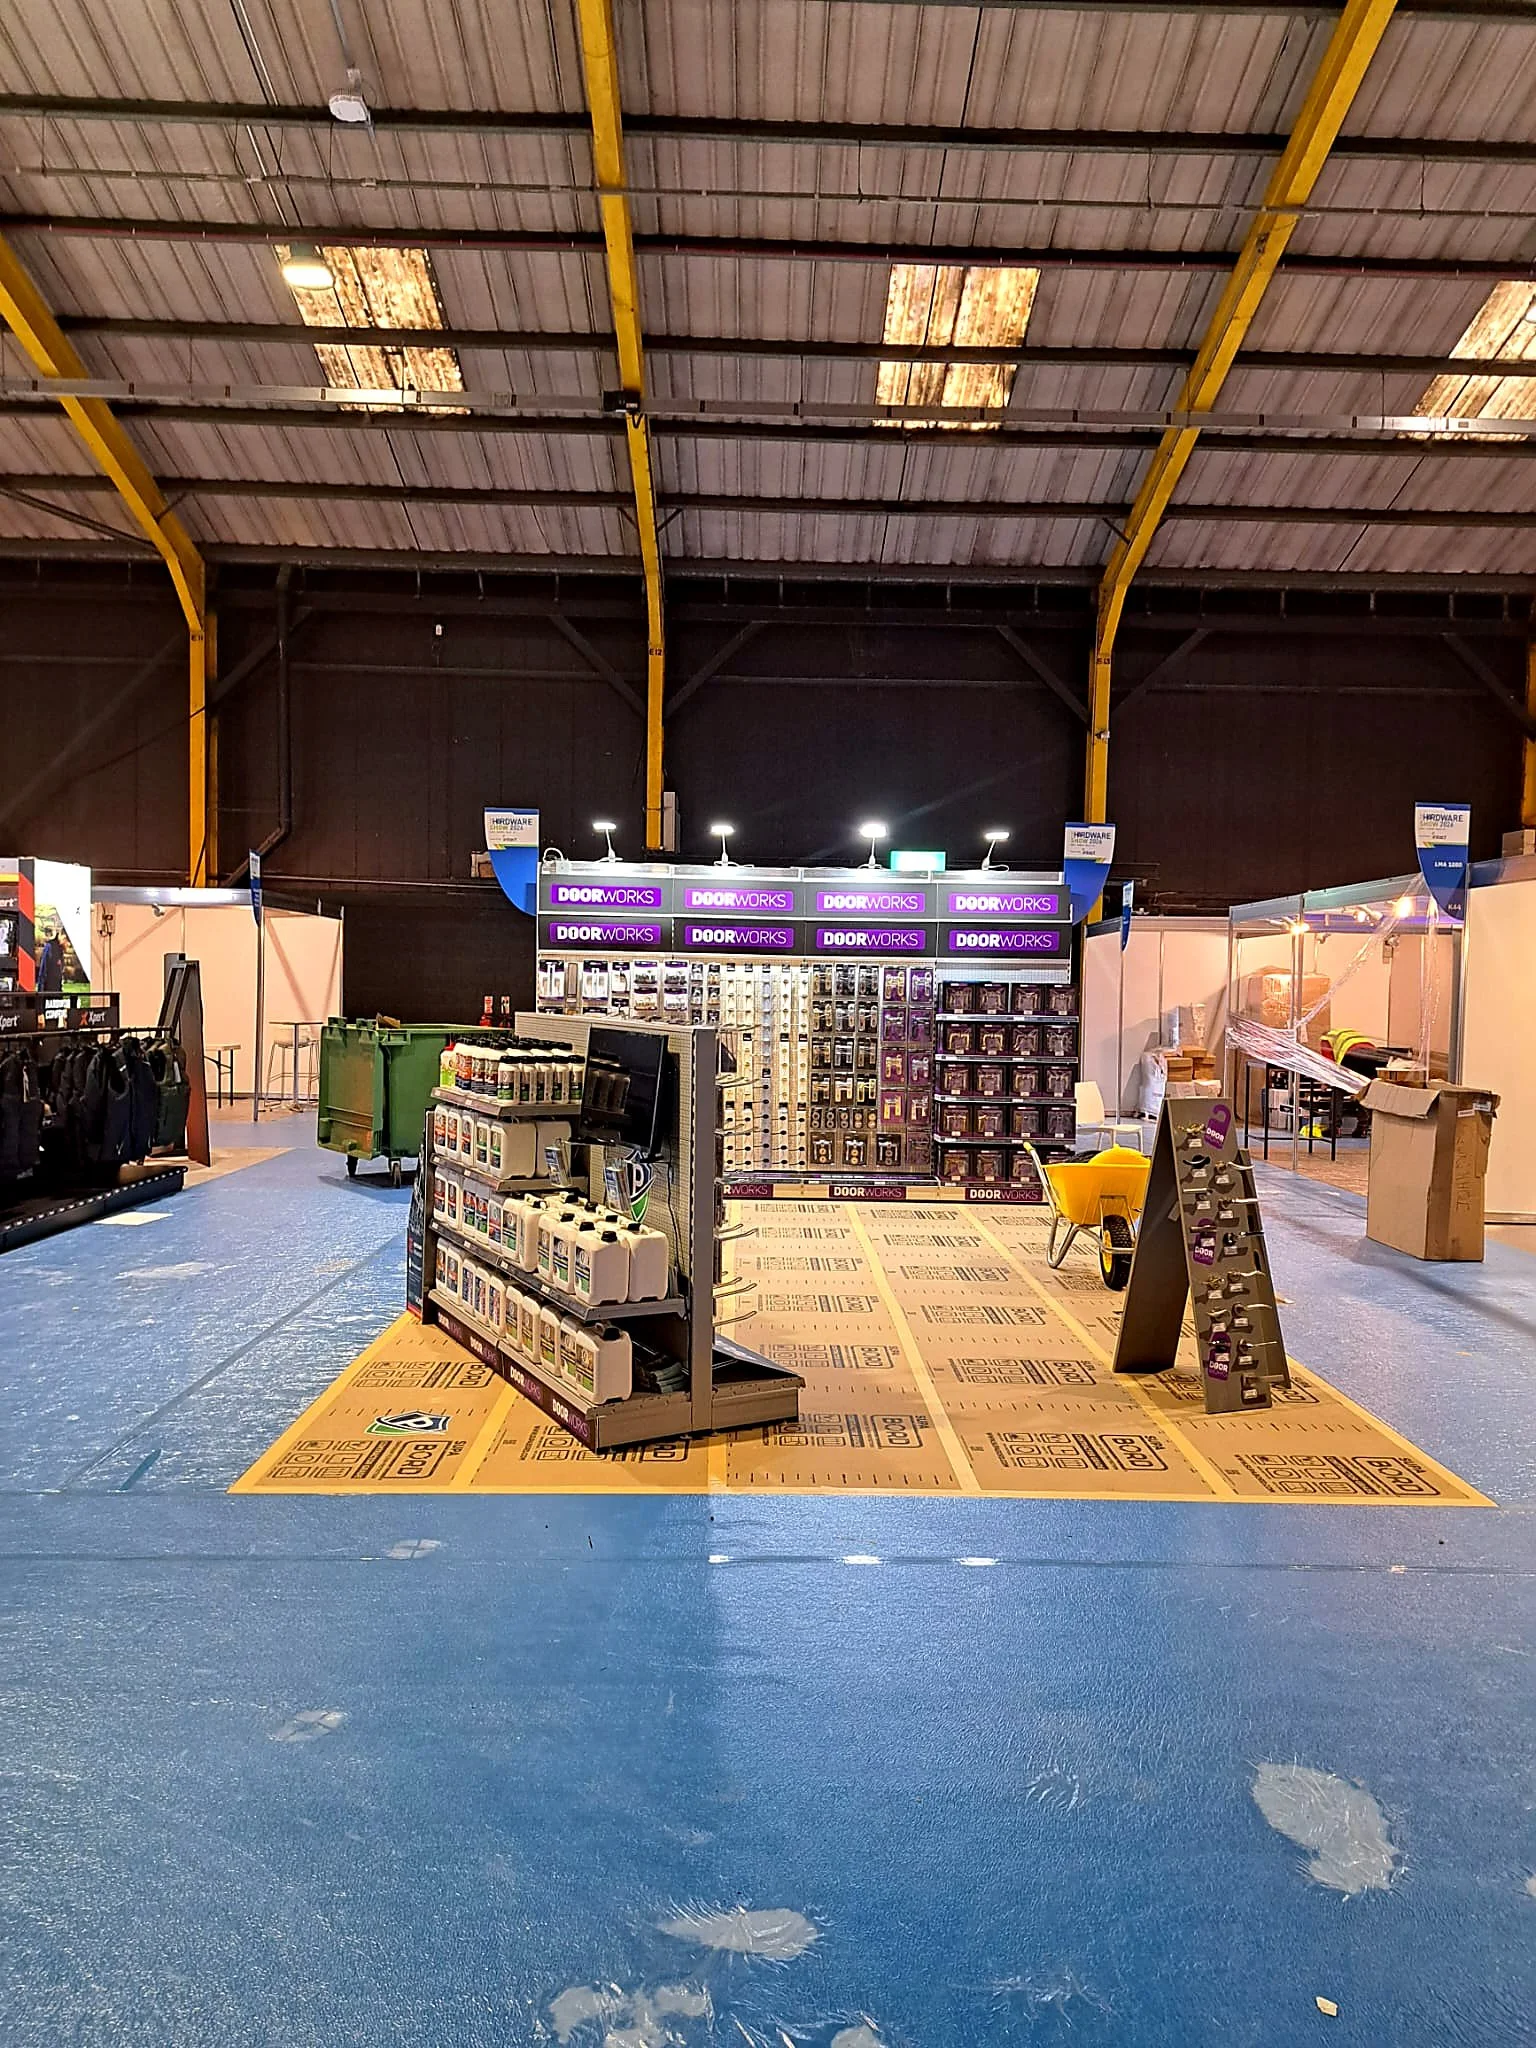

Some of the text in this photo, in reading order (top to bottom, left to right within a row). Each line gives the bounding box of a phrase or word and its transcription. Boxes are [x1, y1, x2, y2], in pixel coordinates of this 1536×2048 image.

[557, 886, 655, 904] DOORWORKS
[691, 891, 787, 908] DOORWORKS
[823, 894, 918, 910] DOORWORKS
[955, 895, 1051, 911] DOORWORKS
[556, 925, 654, 943] DOORWORKS
[691, 927, 787, 945] DOORWORKS
[823, 931, 918, 946] DOORWORKS
[956, 932, 1052, 948] DOORWORKS
[1206, 1127, 1225, 1142] DOOR
[724, 1184, 768, 1196] RWORKS
[833, 1186, 902, 1199] DOORWORKS
[970, 1188, 1038, 1200] DOORWORKS
[1194, 1245, 1214, 1258] DOOR
[1209, 1360, 1229, 1373] DOOR
[510, 1365, 542, 1400] DOORWORKS
[552, 1398, 590, 1437] DOORWORKS
[882, 1417, 910, 1446] BORD
[447, 1440, 468, 1457] SUPA
[1112, 1437, 1154, 1468] BORD
[397, 1443, 438, 1476] BORD
[1367, 1459, 1424, 1492] BORD
